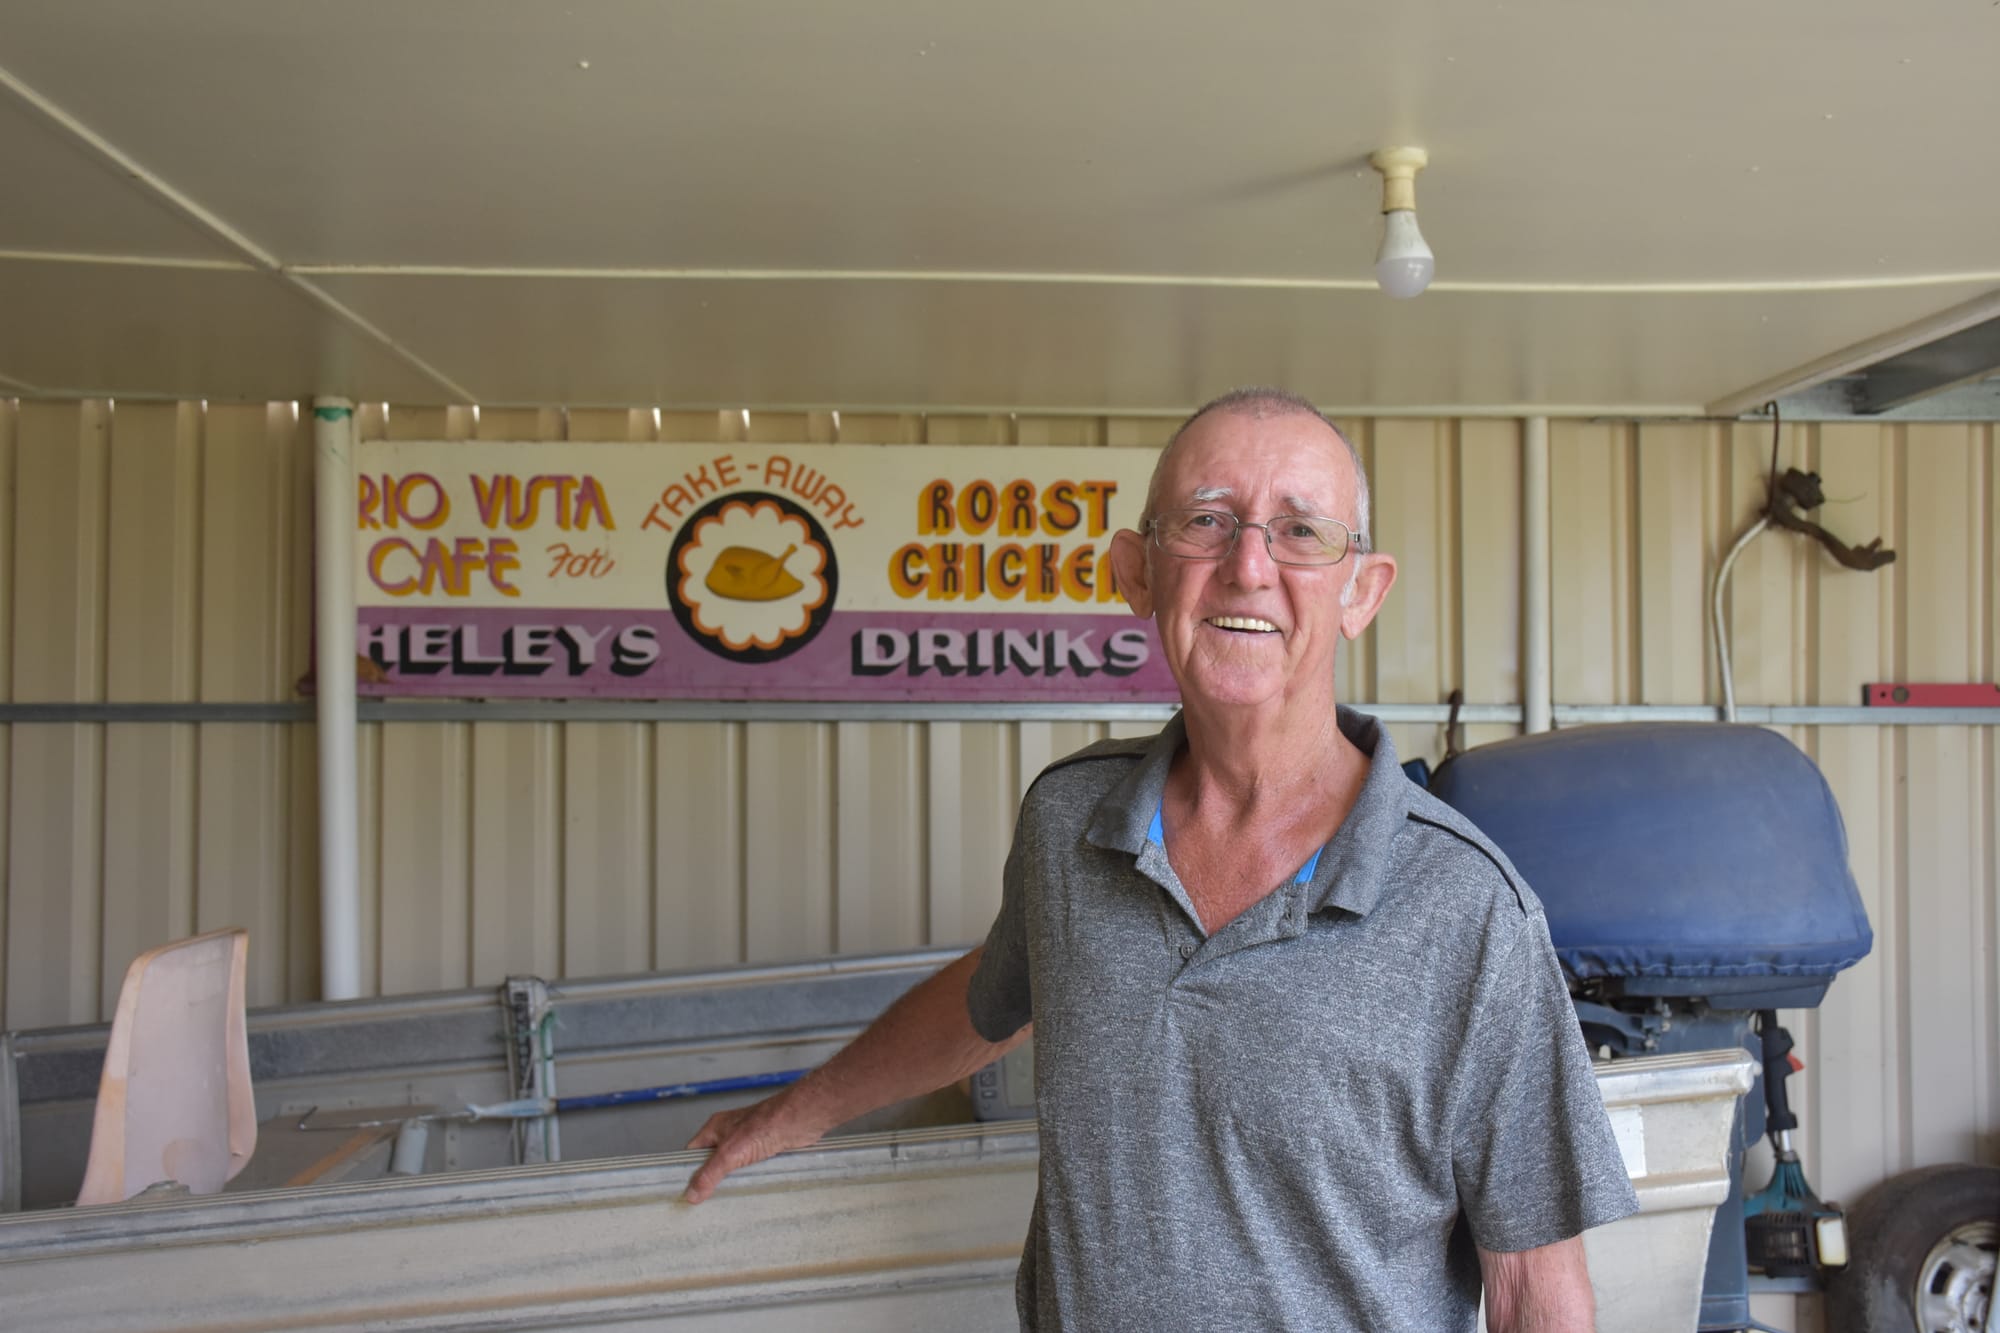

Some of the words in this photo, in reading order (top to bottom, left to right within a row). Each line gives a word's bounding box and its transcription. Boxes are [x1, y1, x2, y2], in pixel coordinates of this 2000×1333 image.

[358, 472, 450, 530] RIO
[469, 473, 616, 531] VISTA
[640, 455, 864, 532] TAKE-AWAY
[918, 479, 1117, 538] ROAST
[367, 536, 521, 597] CAFE
[852, 627, 1149, 678] DRINKS
